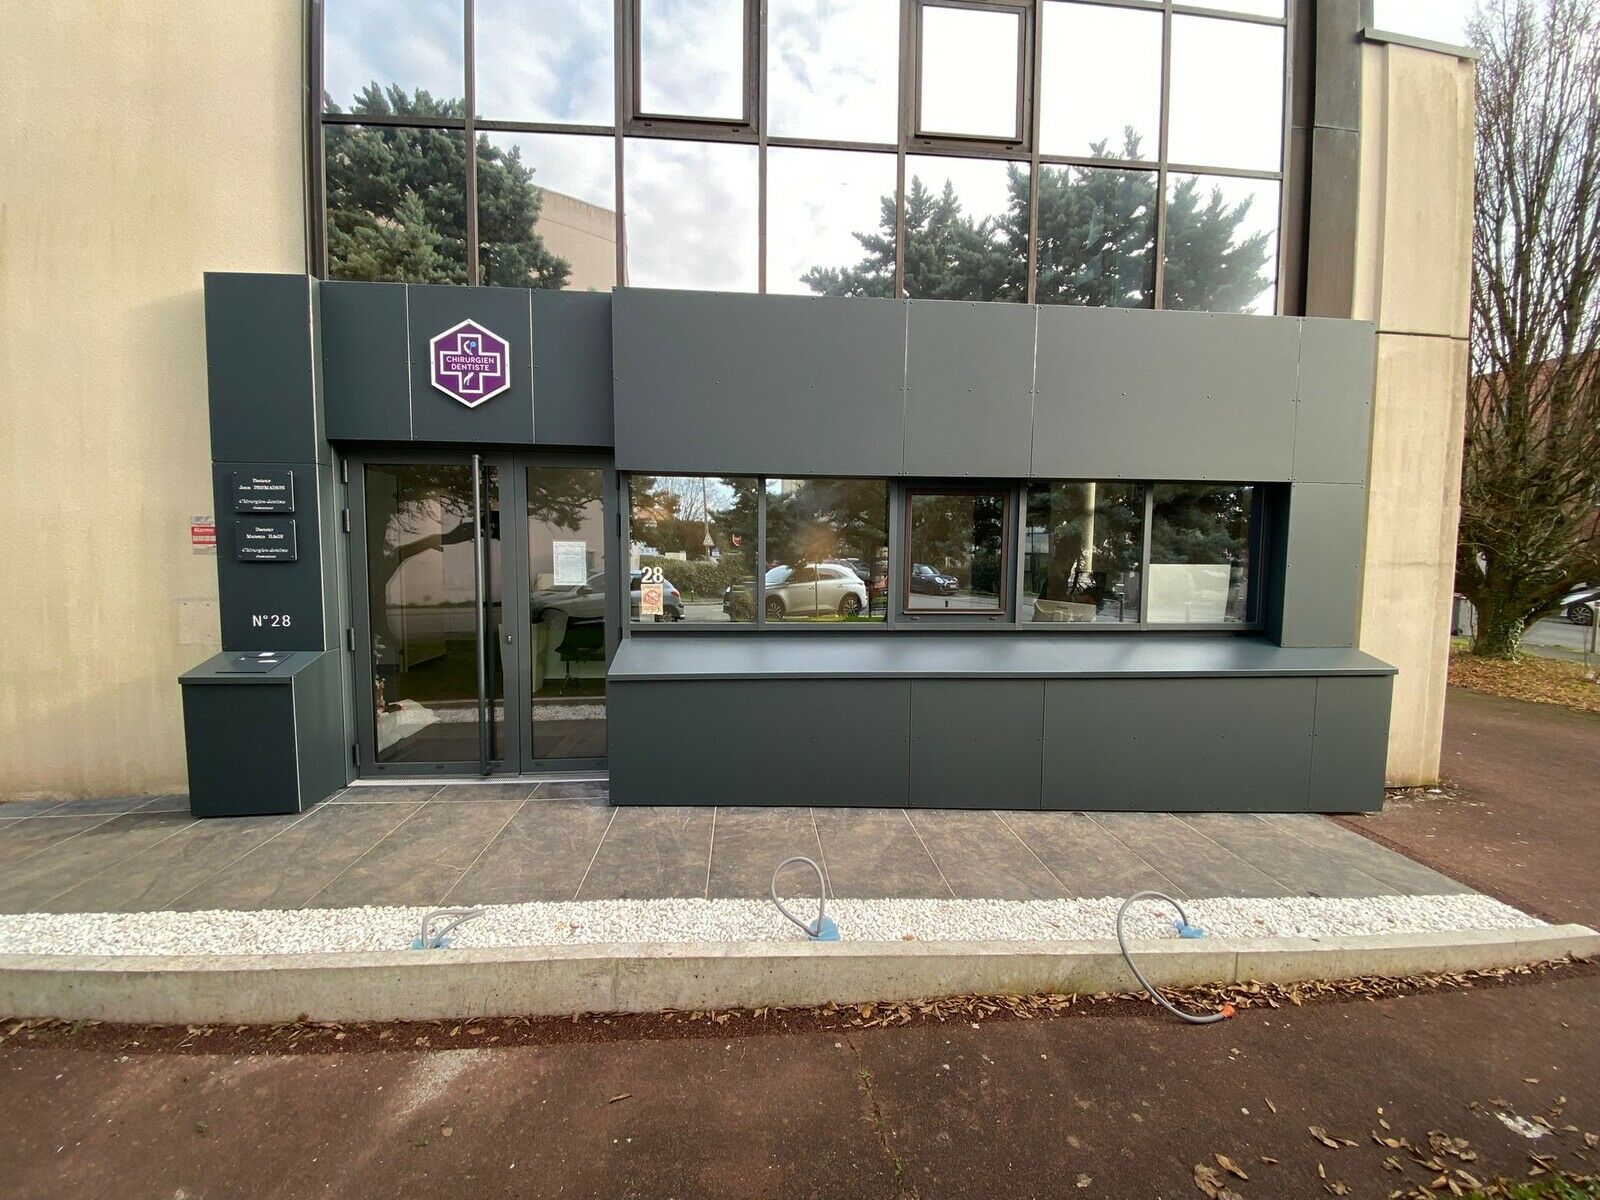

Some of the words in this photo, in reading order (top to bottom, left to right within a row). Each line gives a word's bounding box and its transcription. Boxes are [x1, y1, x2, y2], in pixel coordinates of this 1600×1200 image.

[446, 356, 495, 364] CHIRURGIEN
[451, 363, 490, 371] DENTISTE
[641, 566, 664, 583] 28
